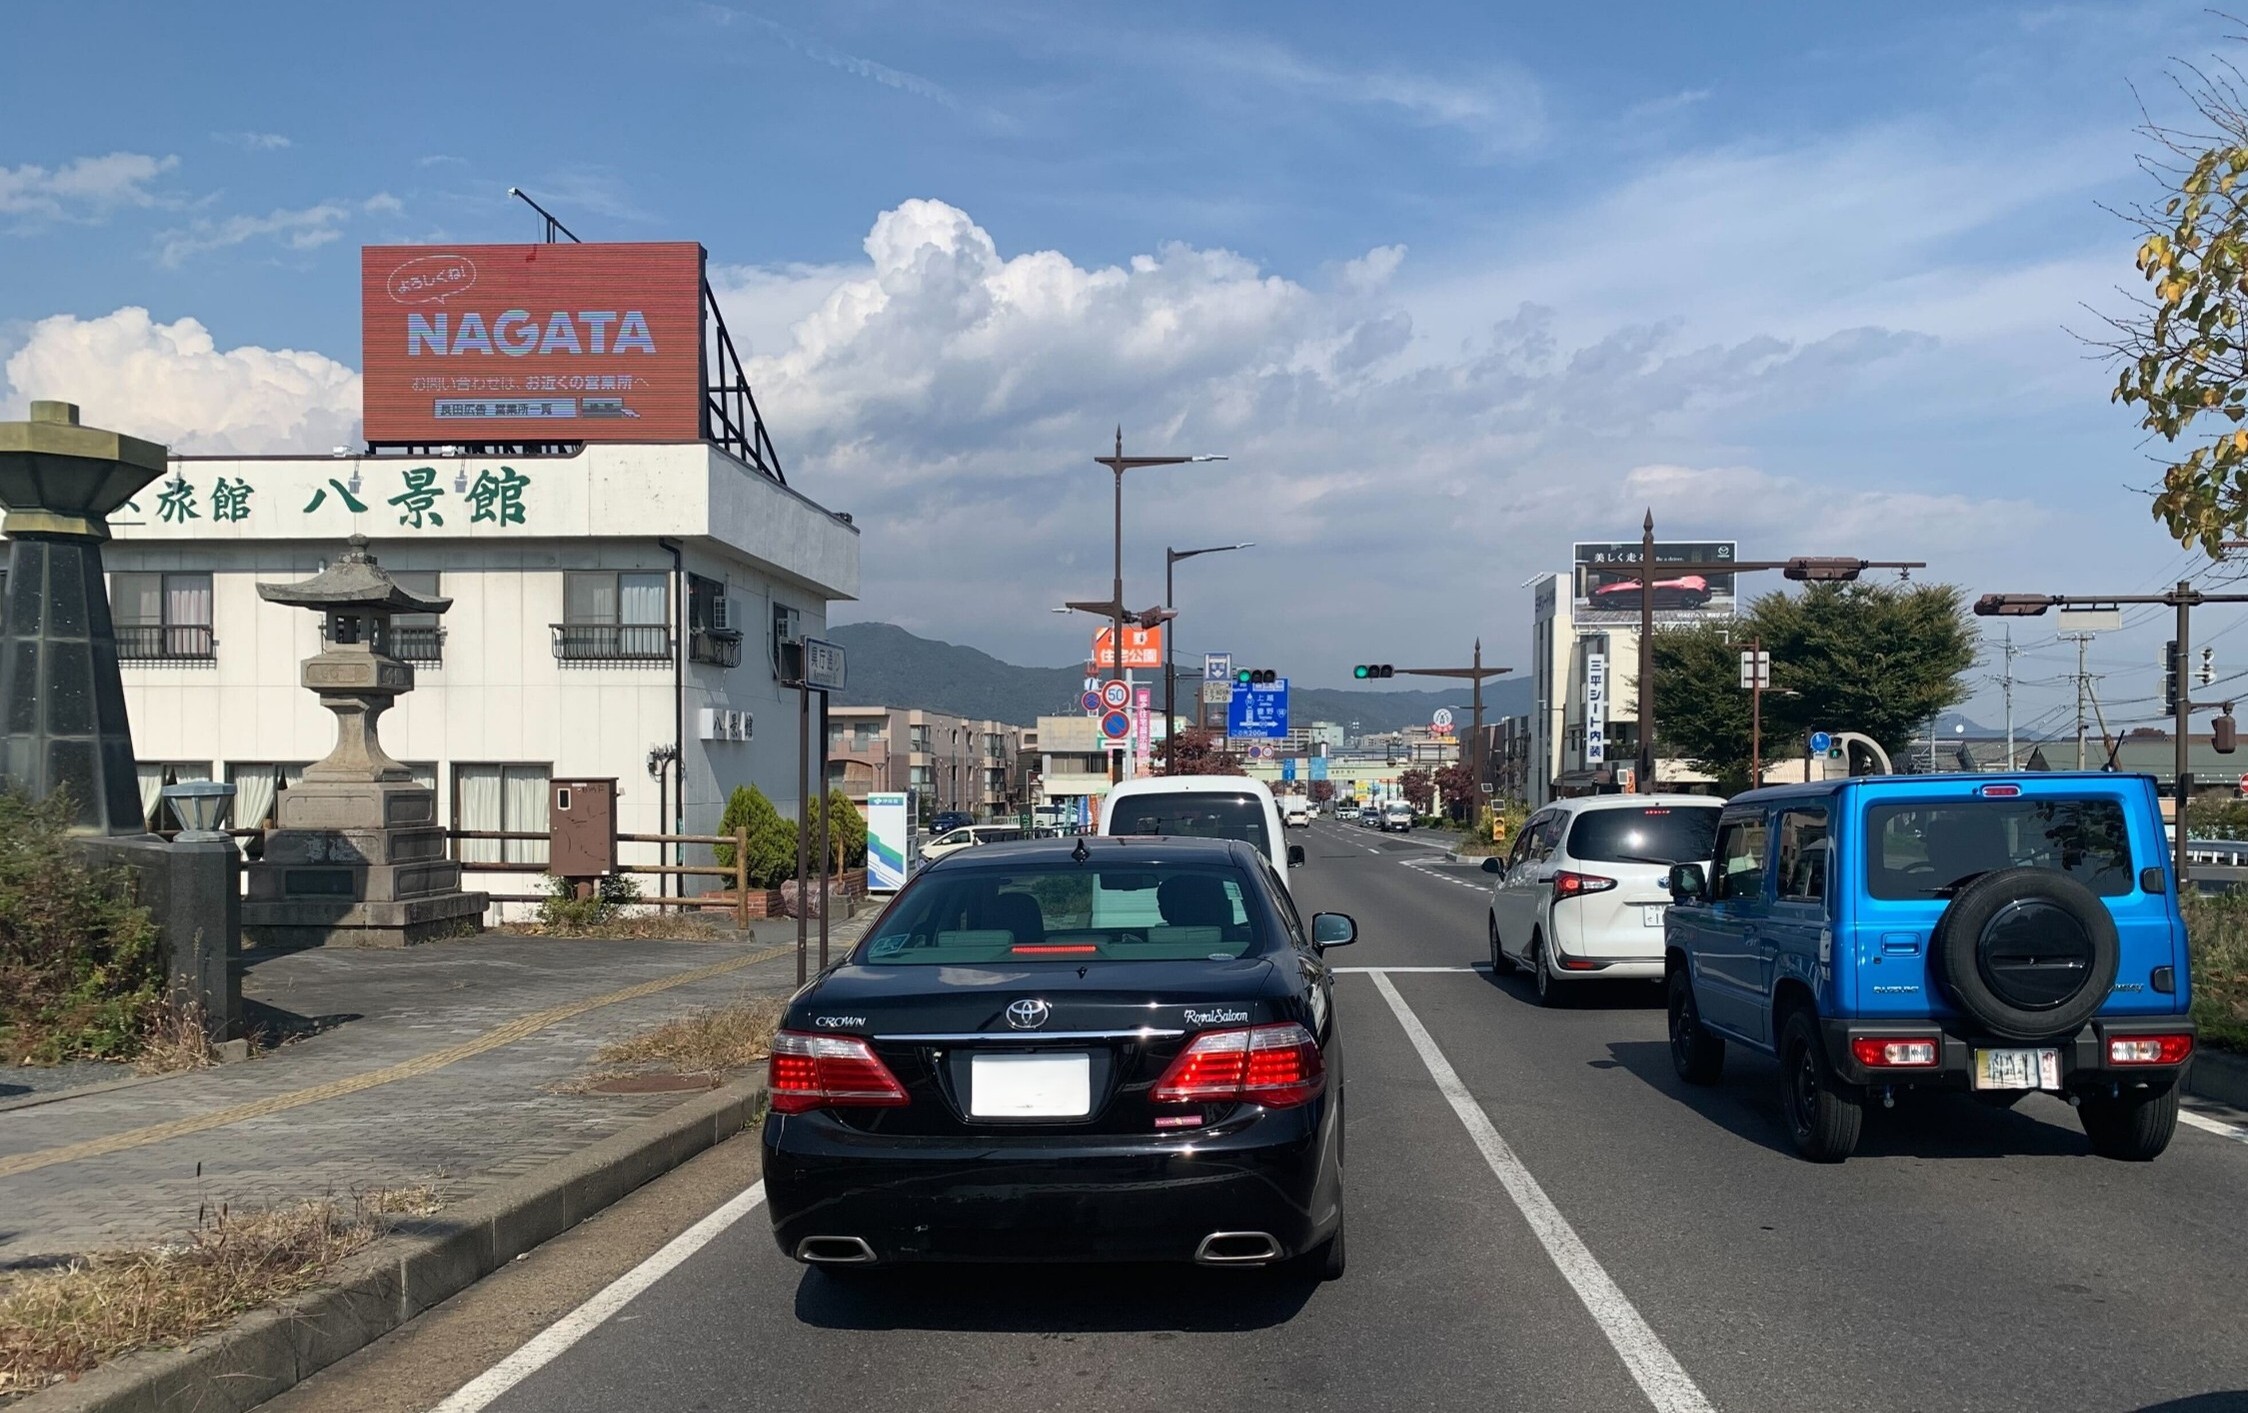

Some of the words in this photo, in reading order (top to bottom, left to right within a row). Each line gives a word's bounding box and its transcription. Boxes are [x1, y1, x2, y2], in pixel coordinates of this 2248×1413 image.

[407, 309, 657, 357] NAGATA
[303, 465, 531, 529] 八景館
[1108, 688, 1124, 701] 50
[1588, 657, 1602, 758] 三平シート内装
[815, 1016, 867, 1028] CROWN
